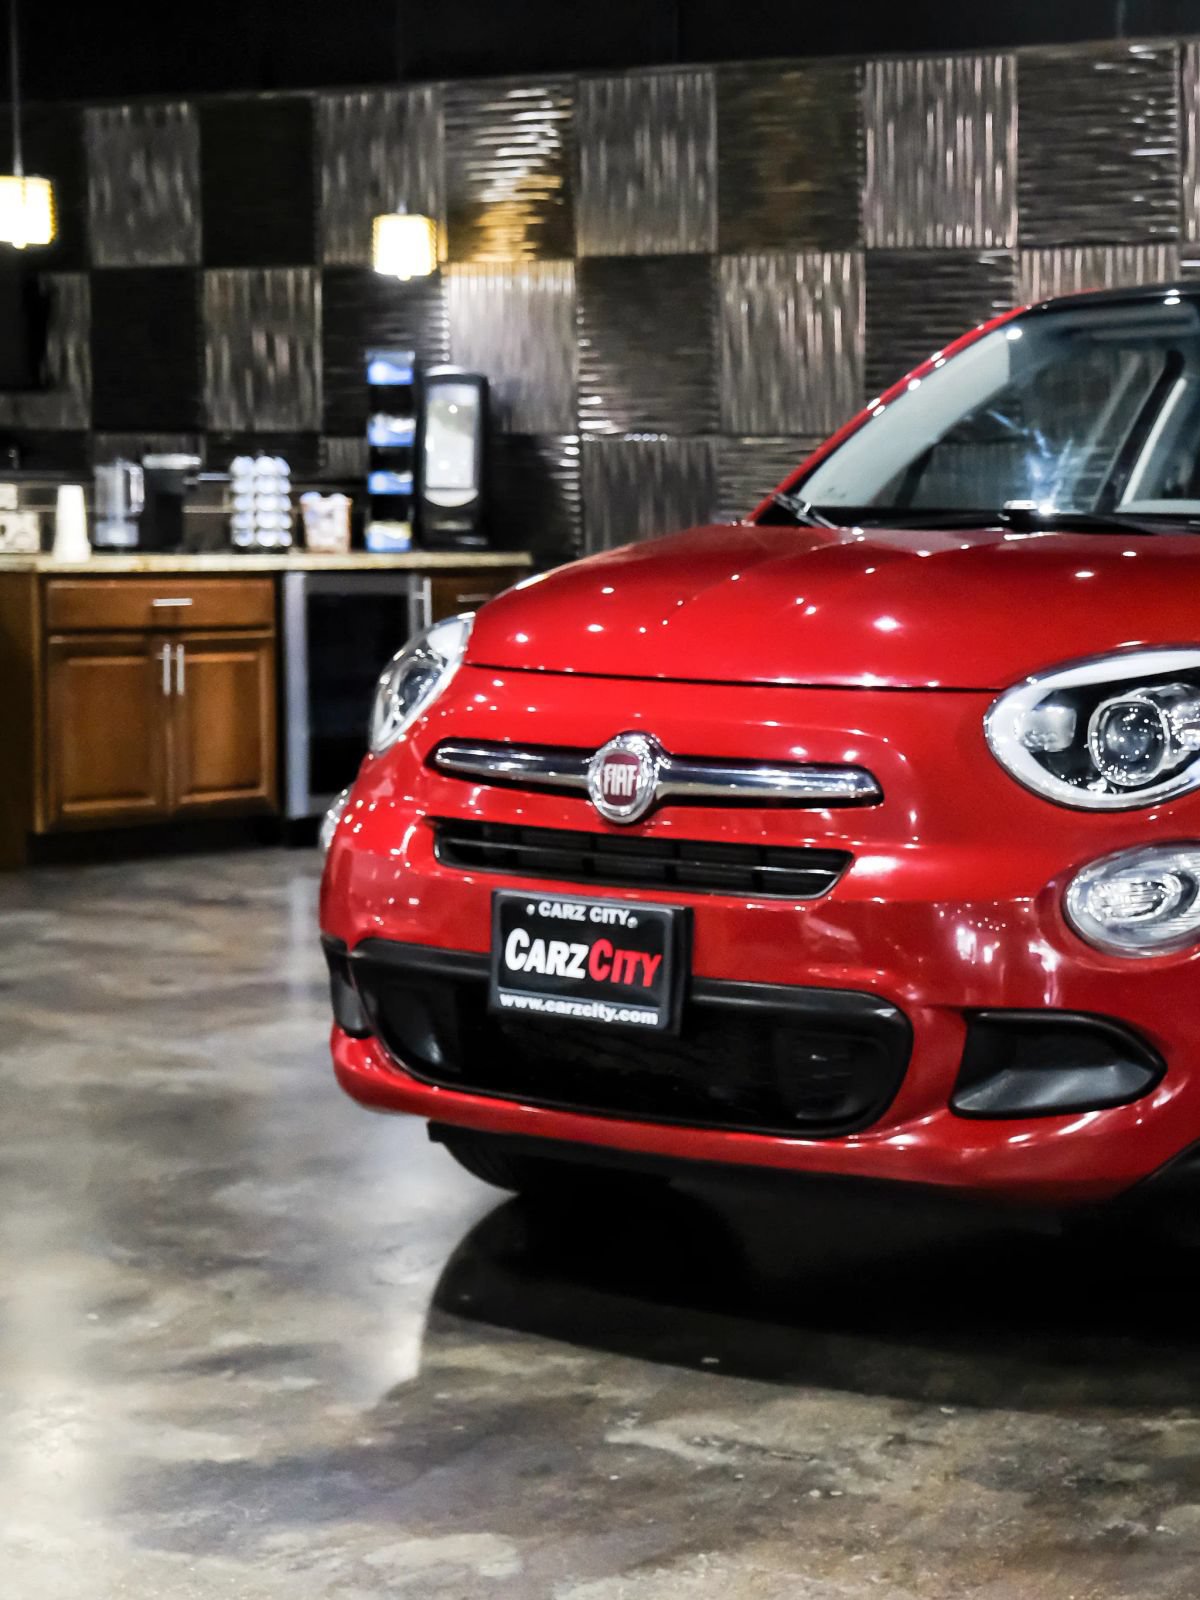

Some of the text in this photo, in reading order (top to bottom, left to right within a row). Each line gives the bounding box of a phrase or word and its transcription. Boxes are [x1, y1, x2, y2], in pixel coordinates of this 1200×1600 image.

[603, 764, 637, 796] FIAT
[538, 901, 630, 925] CARZ CITY
[500, 993, 658, 1025] www.carzcity.com
